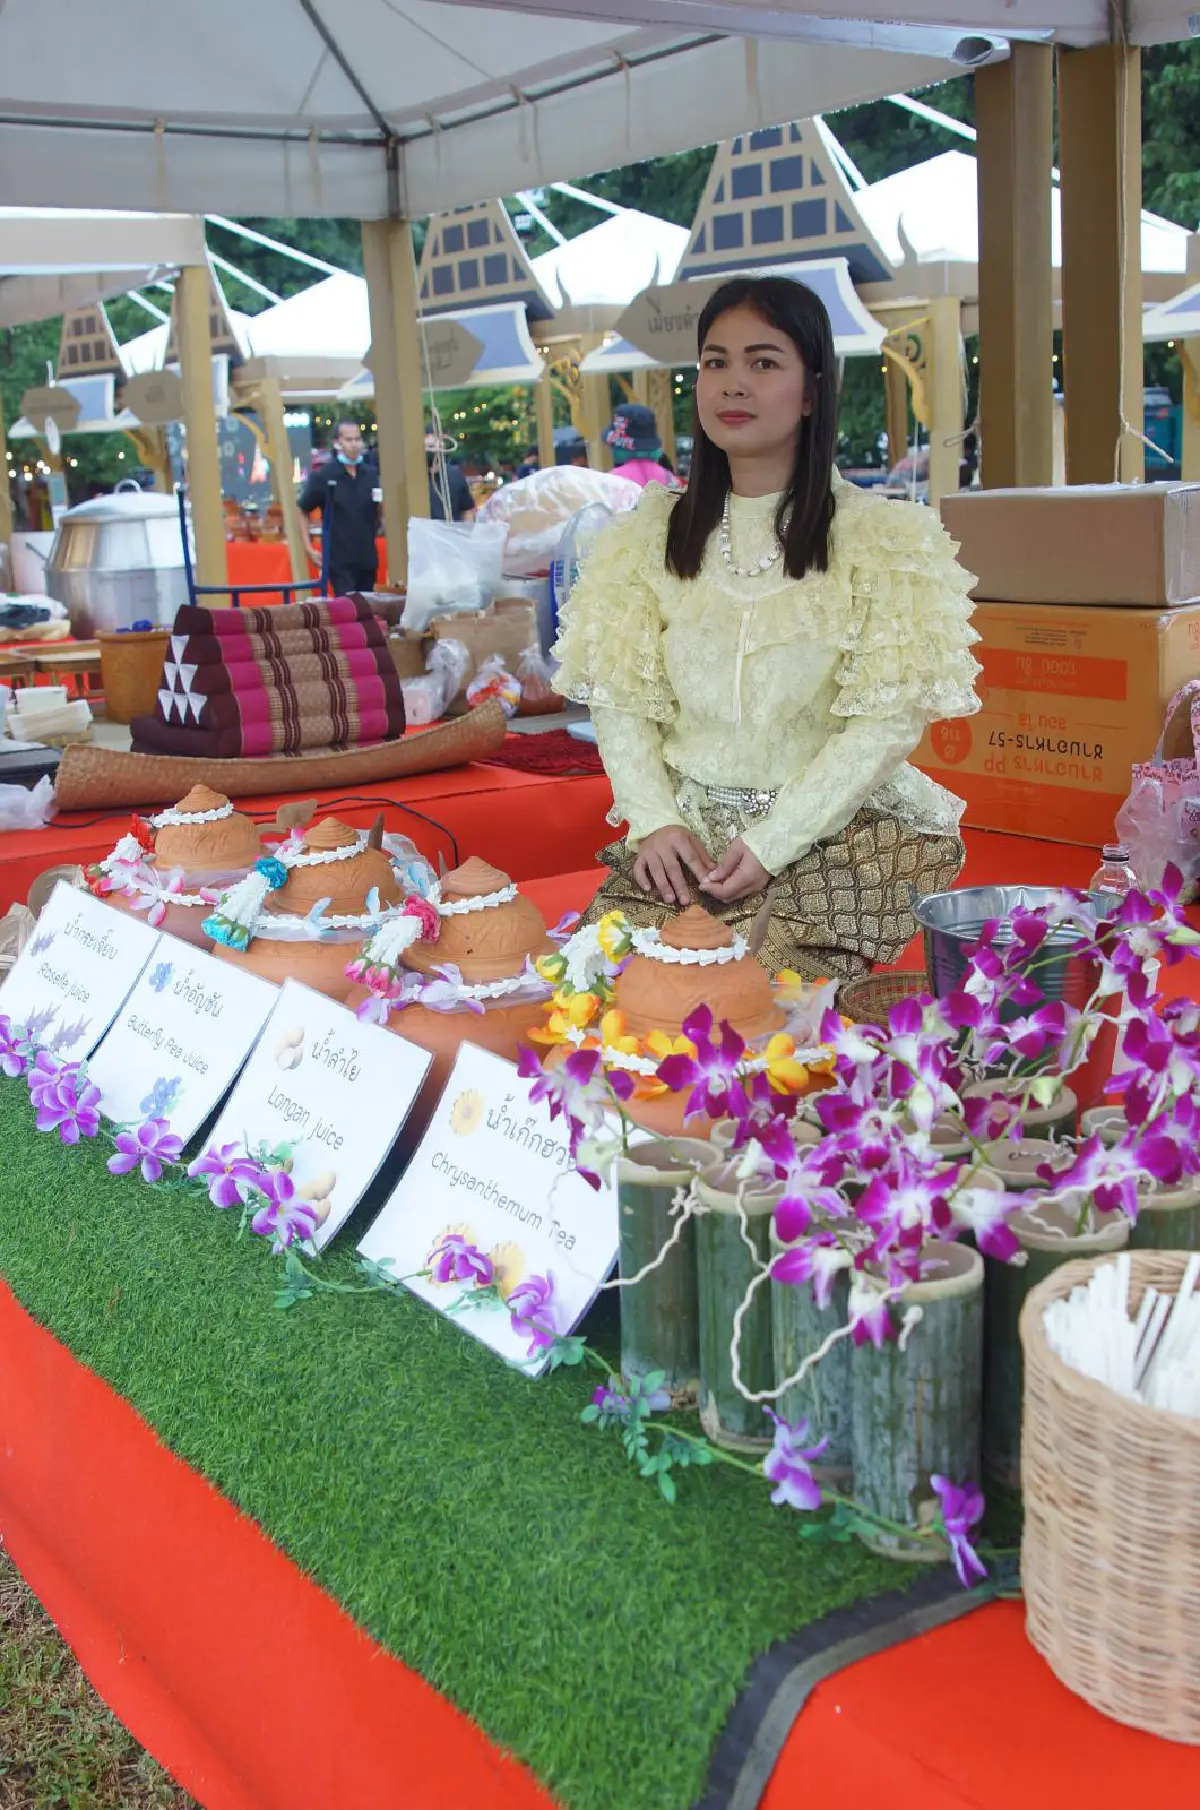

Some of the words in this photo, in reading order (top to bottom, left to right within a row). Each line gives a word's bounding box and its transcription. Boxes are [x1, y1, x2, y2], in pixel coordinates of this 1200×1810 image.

[984, 754, 1007, 774] PP
[267, 1084, 311, 1128] Longan
[307, 1117, 344, 1150] juice
[430, 1151, 544, 1232] Chrysanthemum
[547, 1219, 577, 1251] Tea
